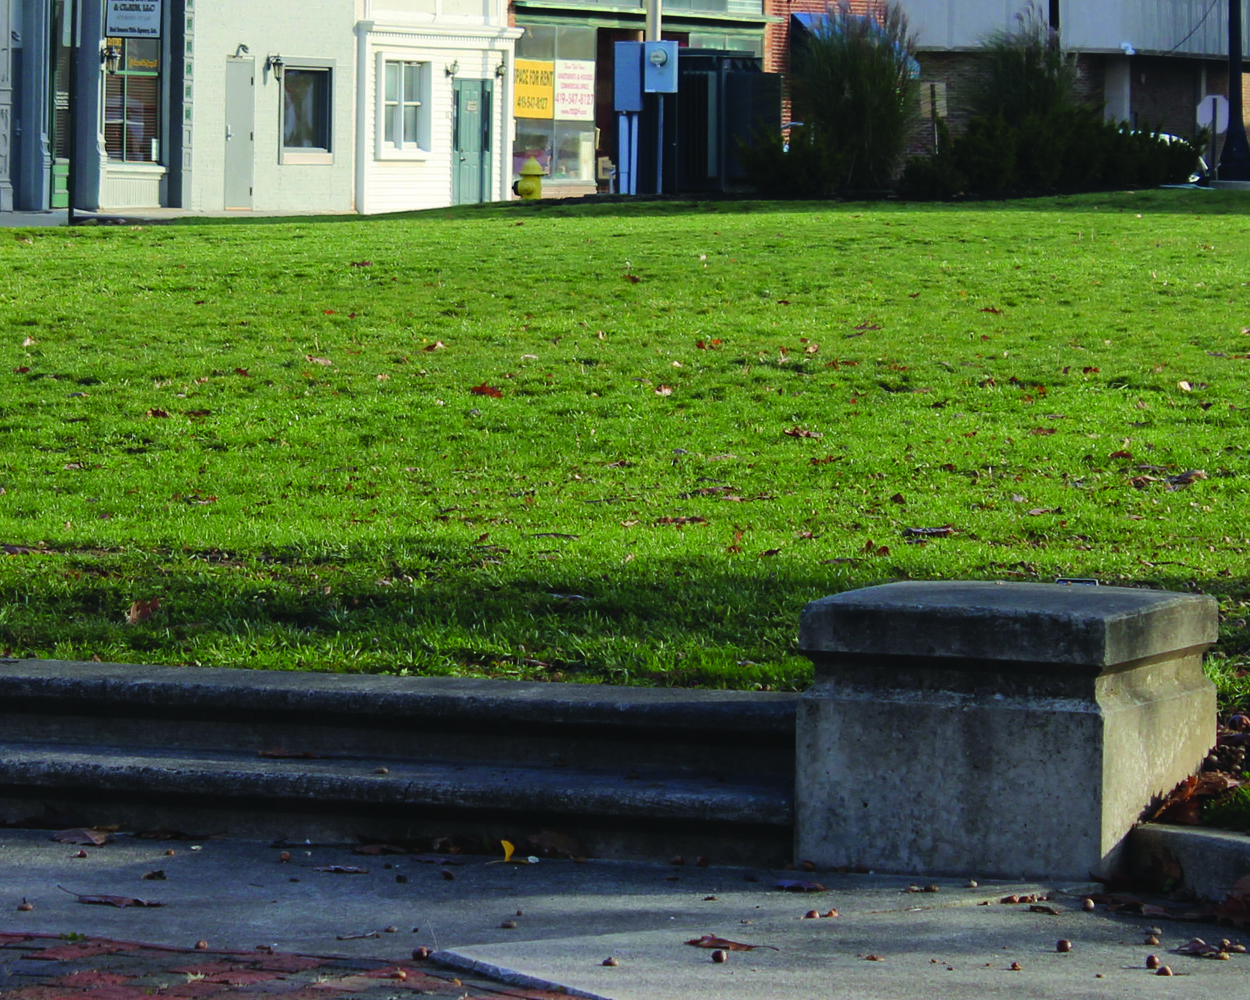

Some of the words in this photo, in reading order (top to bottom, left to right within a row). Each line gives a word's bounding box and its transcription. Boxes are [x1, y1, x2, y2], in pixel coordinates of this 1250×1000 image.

[143, 4, 155, 12] LLC
[529, 68, 539, 86] FOR
[540, 70, 553, 87] RENT
